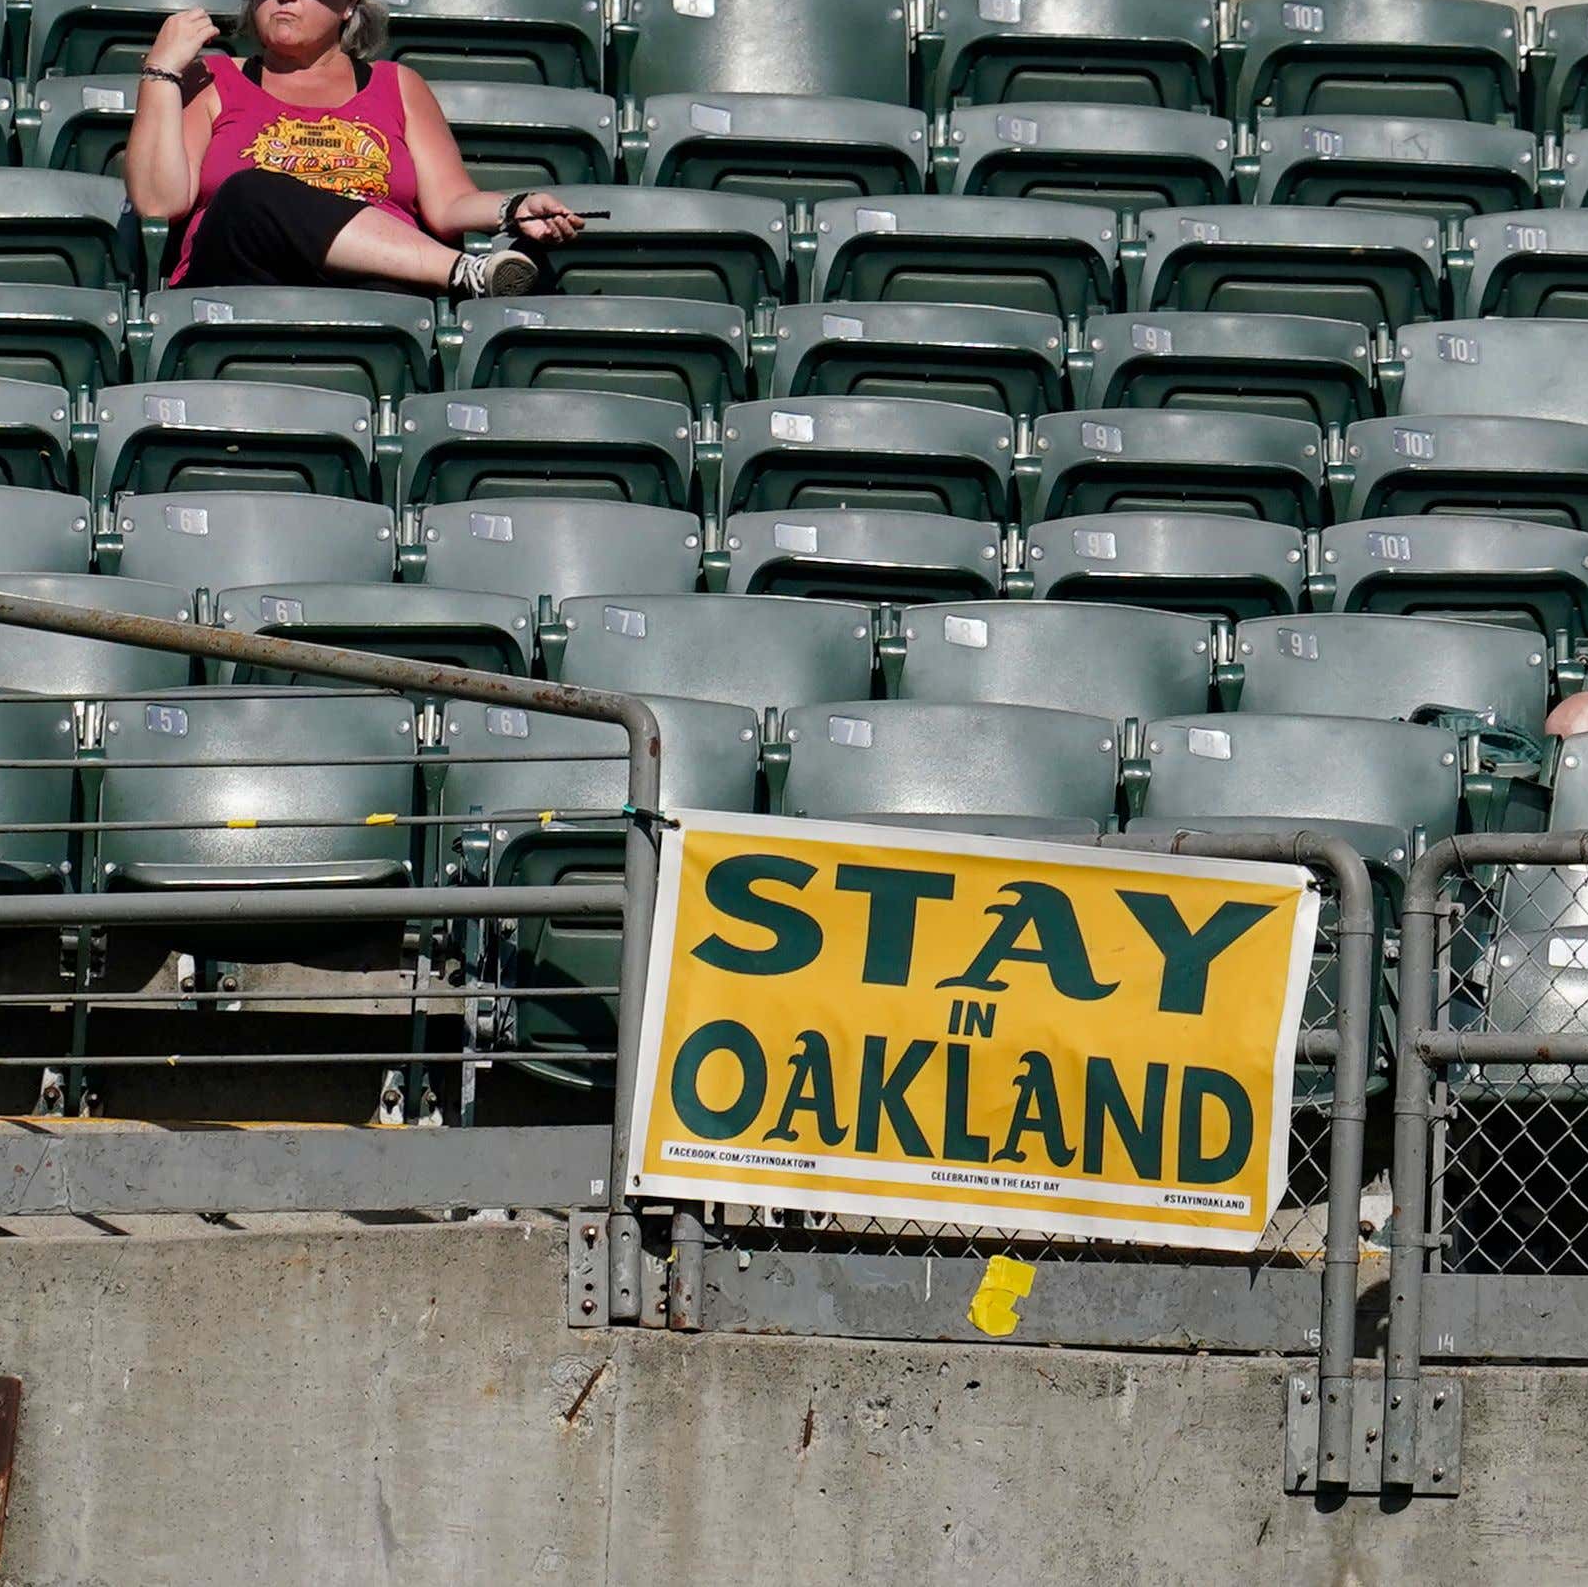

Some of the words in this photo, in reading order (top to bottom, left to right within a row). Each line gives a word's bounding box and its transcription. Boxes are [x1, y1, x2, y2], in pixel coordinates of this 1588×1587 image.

[993, 0, 1005, 20] 9
[1293, 7, 1312, 30] 10
[1315, 131, 1333, 153] 10
[1517, 228, 1536, 252] 10
[1145, 327, 1156, 349] 9
[1447, 338, 1468, 361] 10
[158, 401, 171, 423] 6
[461, 407, 472, 429] 7
[786, 418, 797, 434] 8
[1095, 426, 1107, 448] 9
[1404, 432, 1422, 456] 10
[180, 510, 192, 531] 6
[484, 517, 495, 539] 7
[1088, 535, 1100, 557] 9
[1379, 535, 1399, 558] 10
[276, 601, 288, 623] 6
[618, 611, 630, 633] 7
[1290, 632, 1302, 656] 9
[160, 707, 172, 732] 5
[502, 712, 513, 733] 6
[843, 721, 855, 743] 7
[690, 853, 1280, 1015] STAY
[947, 999, 997, 1039] IN
[671, 1019, 1255, 1185] OAKLAND
[669, 1146, 816, 1170] FACEBOOK.COM/STAYINOAKTOWN
[931, 1171, 990, 1185] CELEBRATING
[991, 1177, 1000, 1186] IN
[1002, 1178, 1018, 1188] THE
[1020, 1179, 1041, 1191] EAST
[1044, 1181, 1060, 1192] BAY
[1163, 1194, 1245, 1210] #STAYINOAKLAND
[1438, 1333, 1454, 1352] 14
